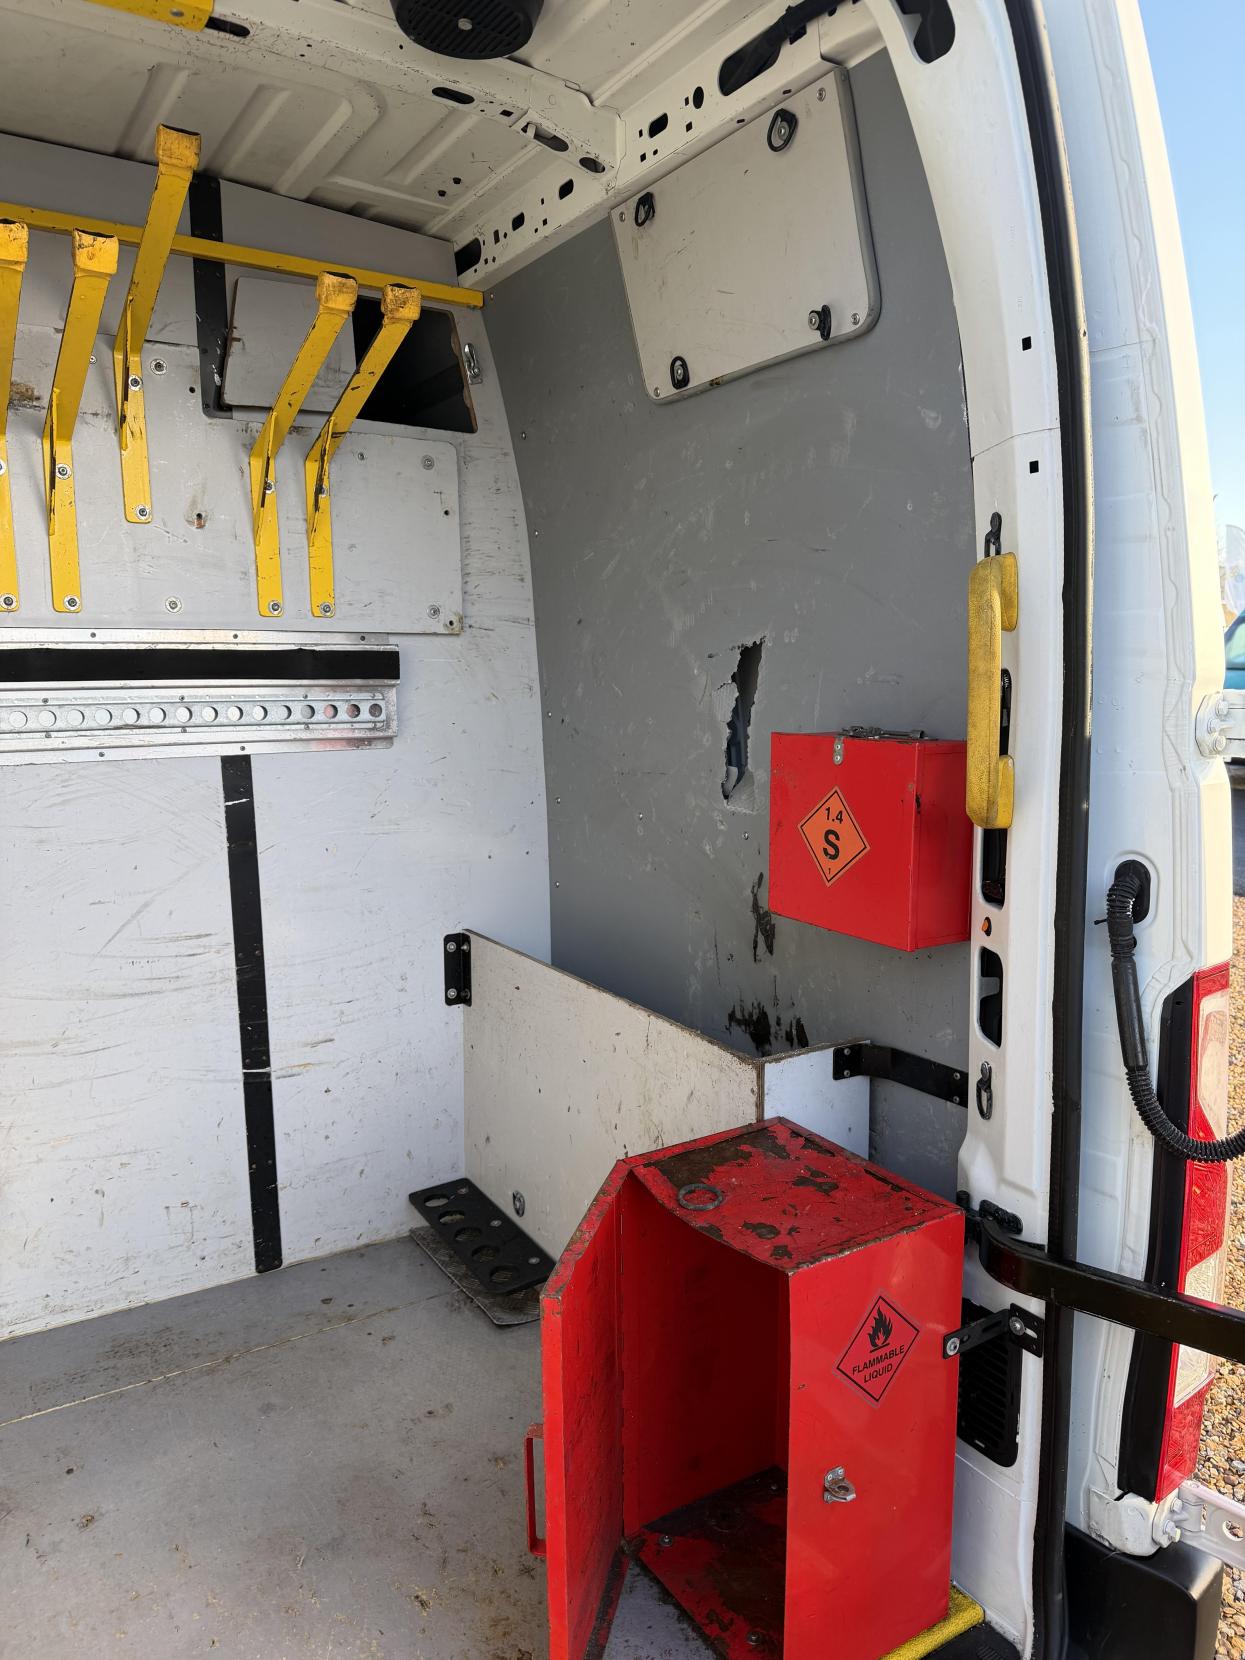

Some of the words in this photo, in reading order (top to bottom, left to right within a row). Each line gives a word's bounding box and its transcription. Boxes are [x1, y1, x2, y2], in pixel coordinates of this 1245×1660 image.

[825, 807, 843, 824] 1.4
[823, 829, 840, 860] S
[852, 1344, 905, 1375] FLAMMABLE
[863, 1363, 893, 1383] LIQUID
